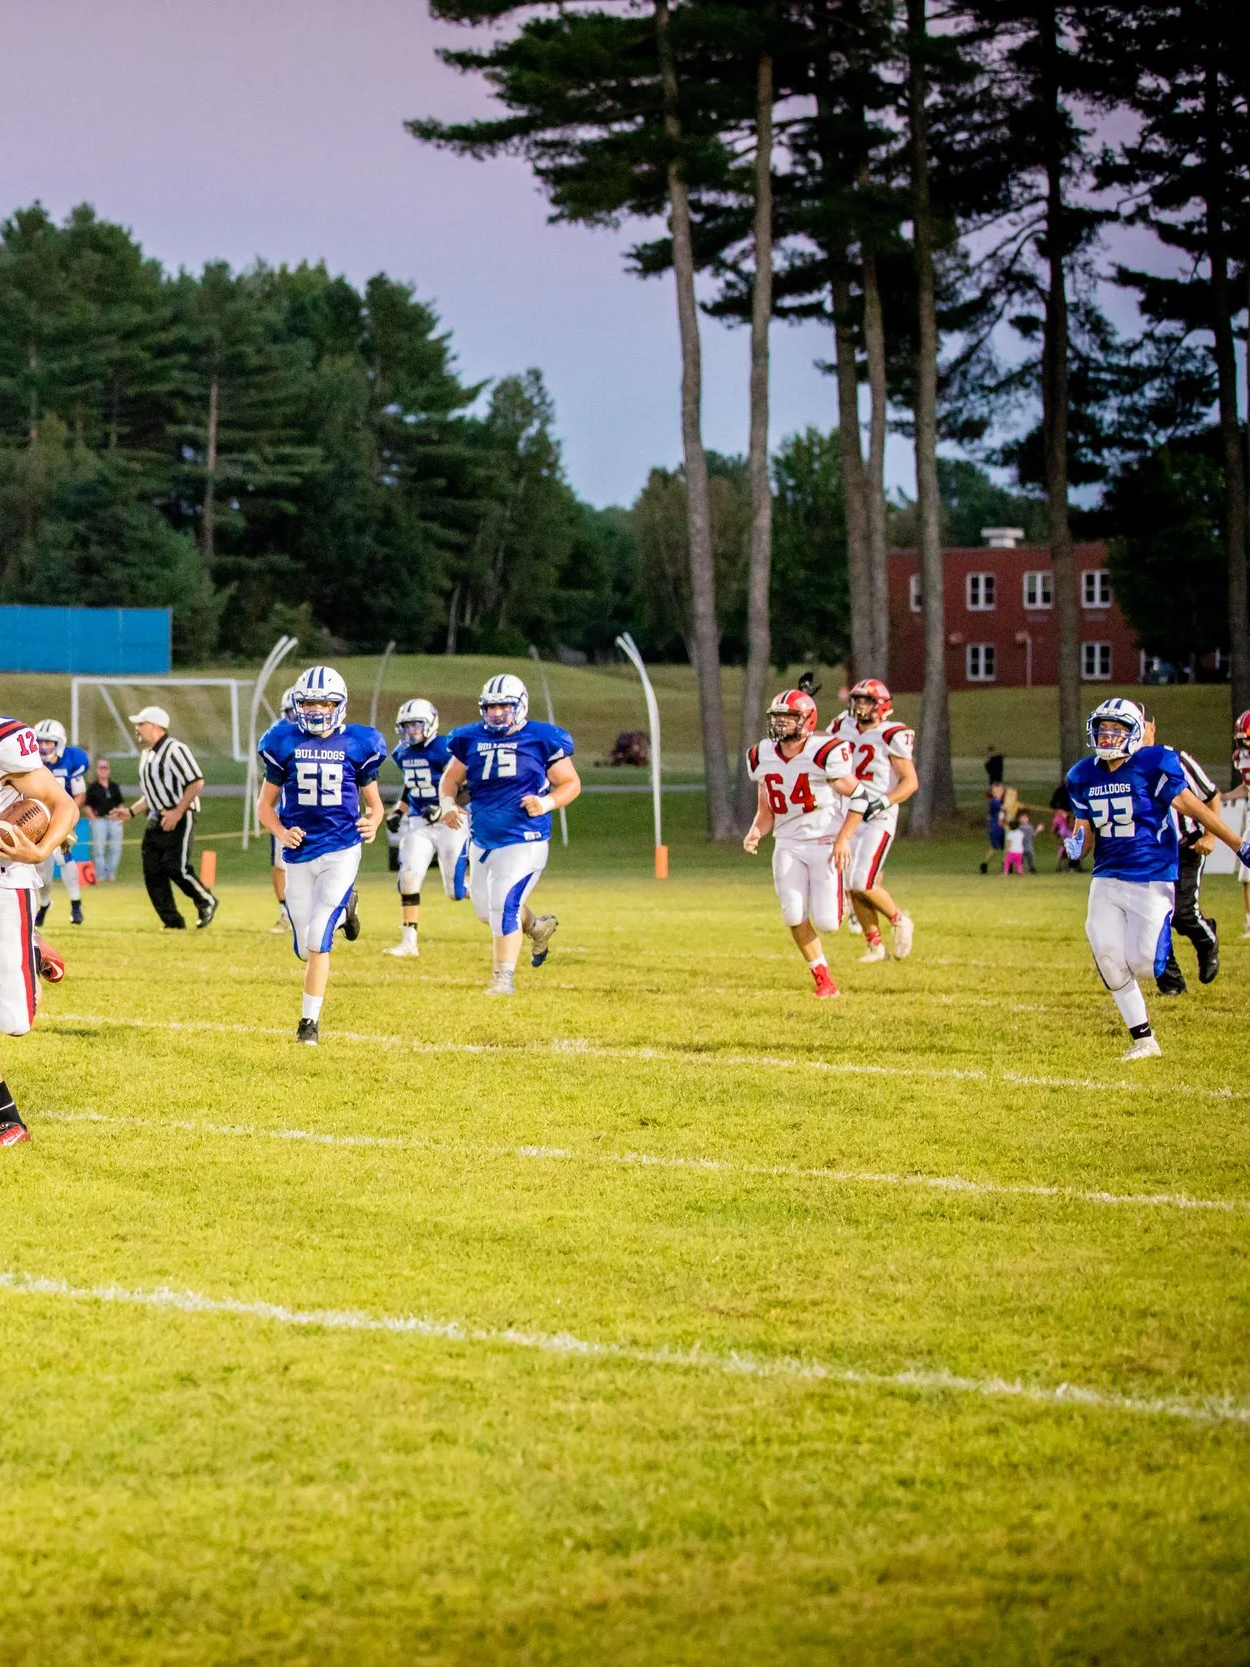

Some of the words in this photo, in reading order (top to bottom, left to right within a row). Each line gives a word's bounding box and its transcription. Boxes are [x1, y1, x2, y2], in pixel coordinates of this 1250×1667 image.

[17, 731, 39, 756] 12
[295, 748, 346, 761] BULLDOGS
[479, 748, 517, 780] 75
[295, 762, 344, 806] 59
[764, 773, 817, 815] 64
[1086, 783, 1132, 797] BULLDOGS
